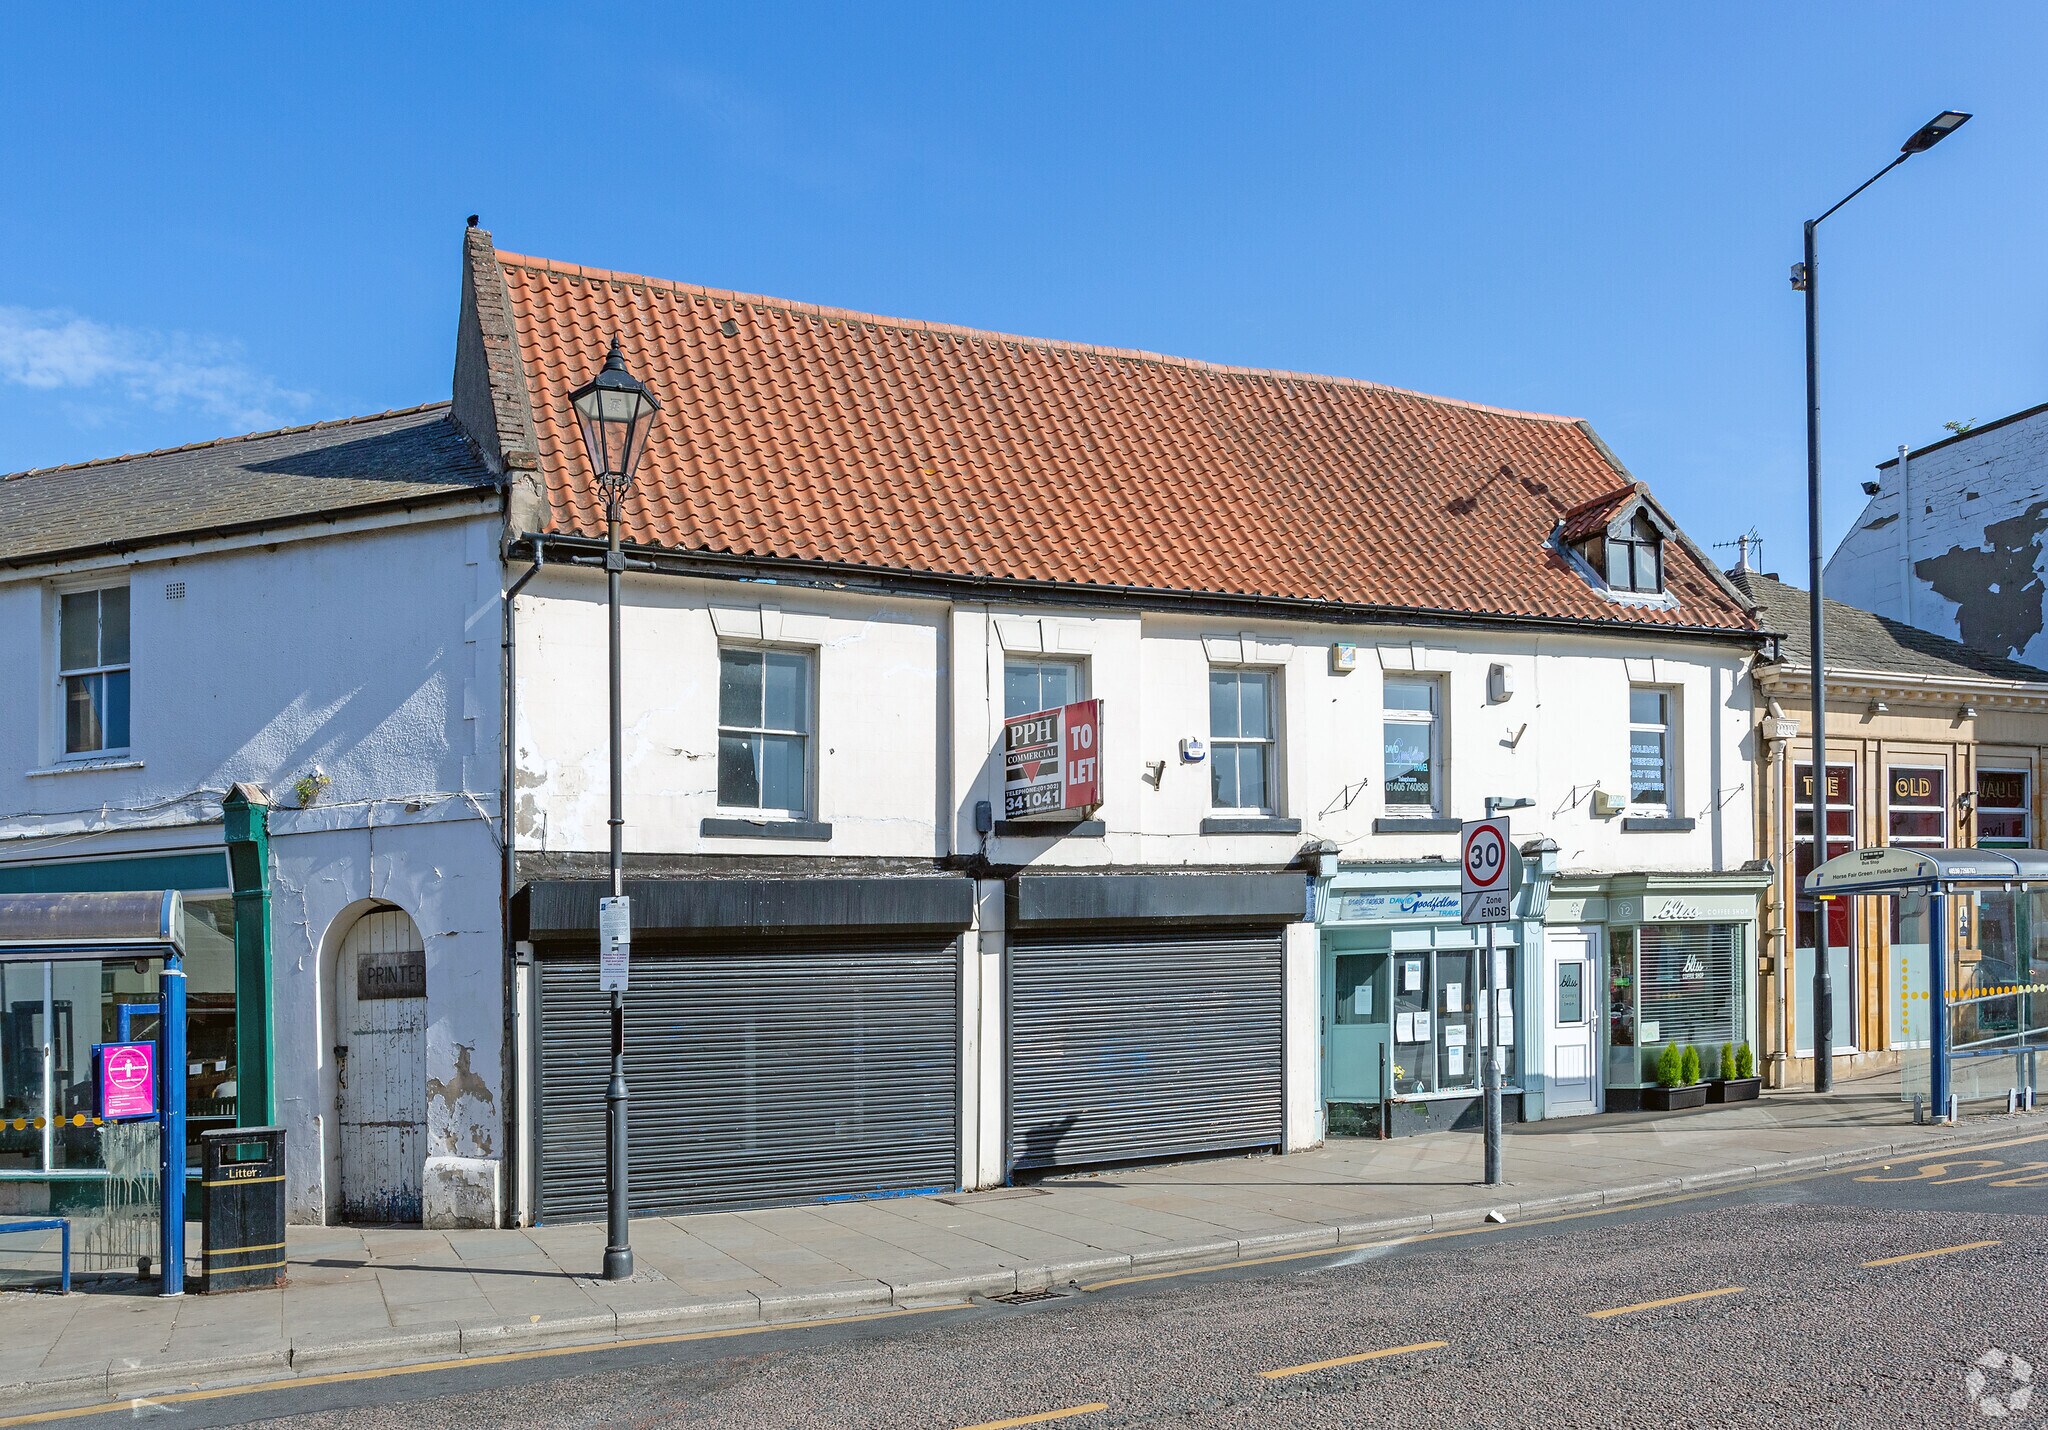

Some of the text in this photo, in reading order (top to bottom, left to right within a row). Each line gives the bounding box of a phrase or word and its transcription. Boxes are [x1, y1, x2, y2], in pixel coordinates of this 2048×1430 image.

[1010, 719, 1052, 748] PPH
[1070, 723, 1093, 751] TO
[1007, 748, 1057, 765] COMMERCIAL
[1631, 745, 1659, 754] HOLIDAYS
[1631, 757, 1664, 766] WEEKENDS
[1069, 757, 1096, 786] LET
[1632, 770, 1661, 778] DAY TRIPS
[1632, 782, 1665, 791] COACH HIRE
[1803, 775, 1839, 797] TE
[1895, 777, 1932, 797] OLD
[1978, 780, 2022, 798] VAULT
[1006, 790, 1060, 811] 341041
[1982, 822, 2006, 837] evil
[1470, 842, 1500, 869] 30
[1400, 891, 1459, 914] Goodfellow
[1486, 896, 1502, 904] Zone
[1652, 898, 1703, 920] bliss
[1481, 906, 1507, 918] ENDS
[1619, 907, 1631, 915] 12
[1682, 954, 1705, 973] bliss
[367, 964, 426, 985] PRINTER
[1559, 974, 1578, 987] bliss
[229, 1168, 258, 1179] Litter
